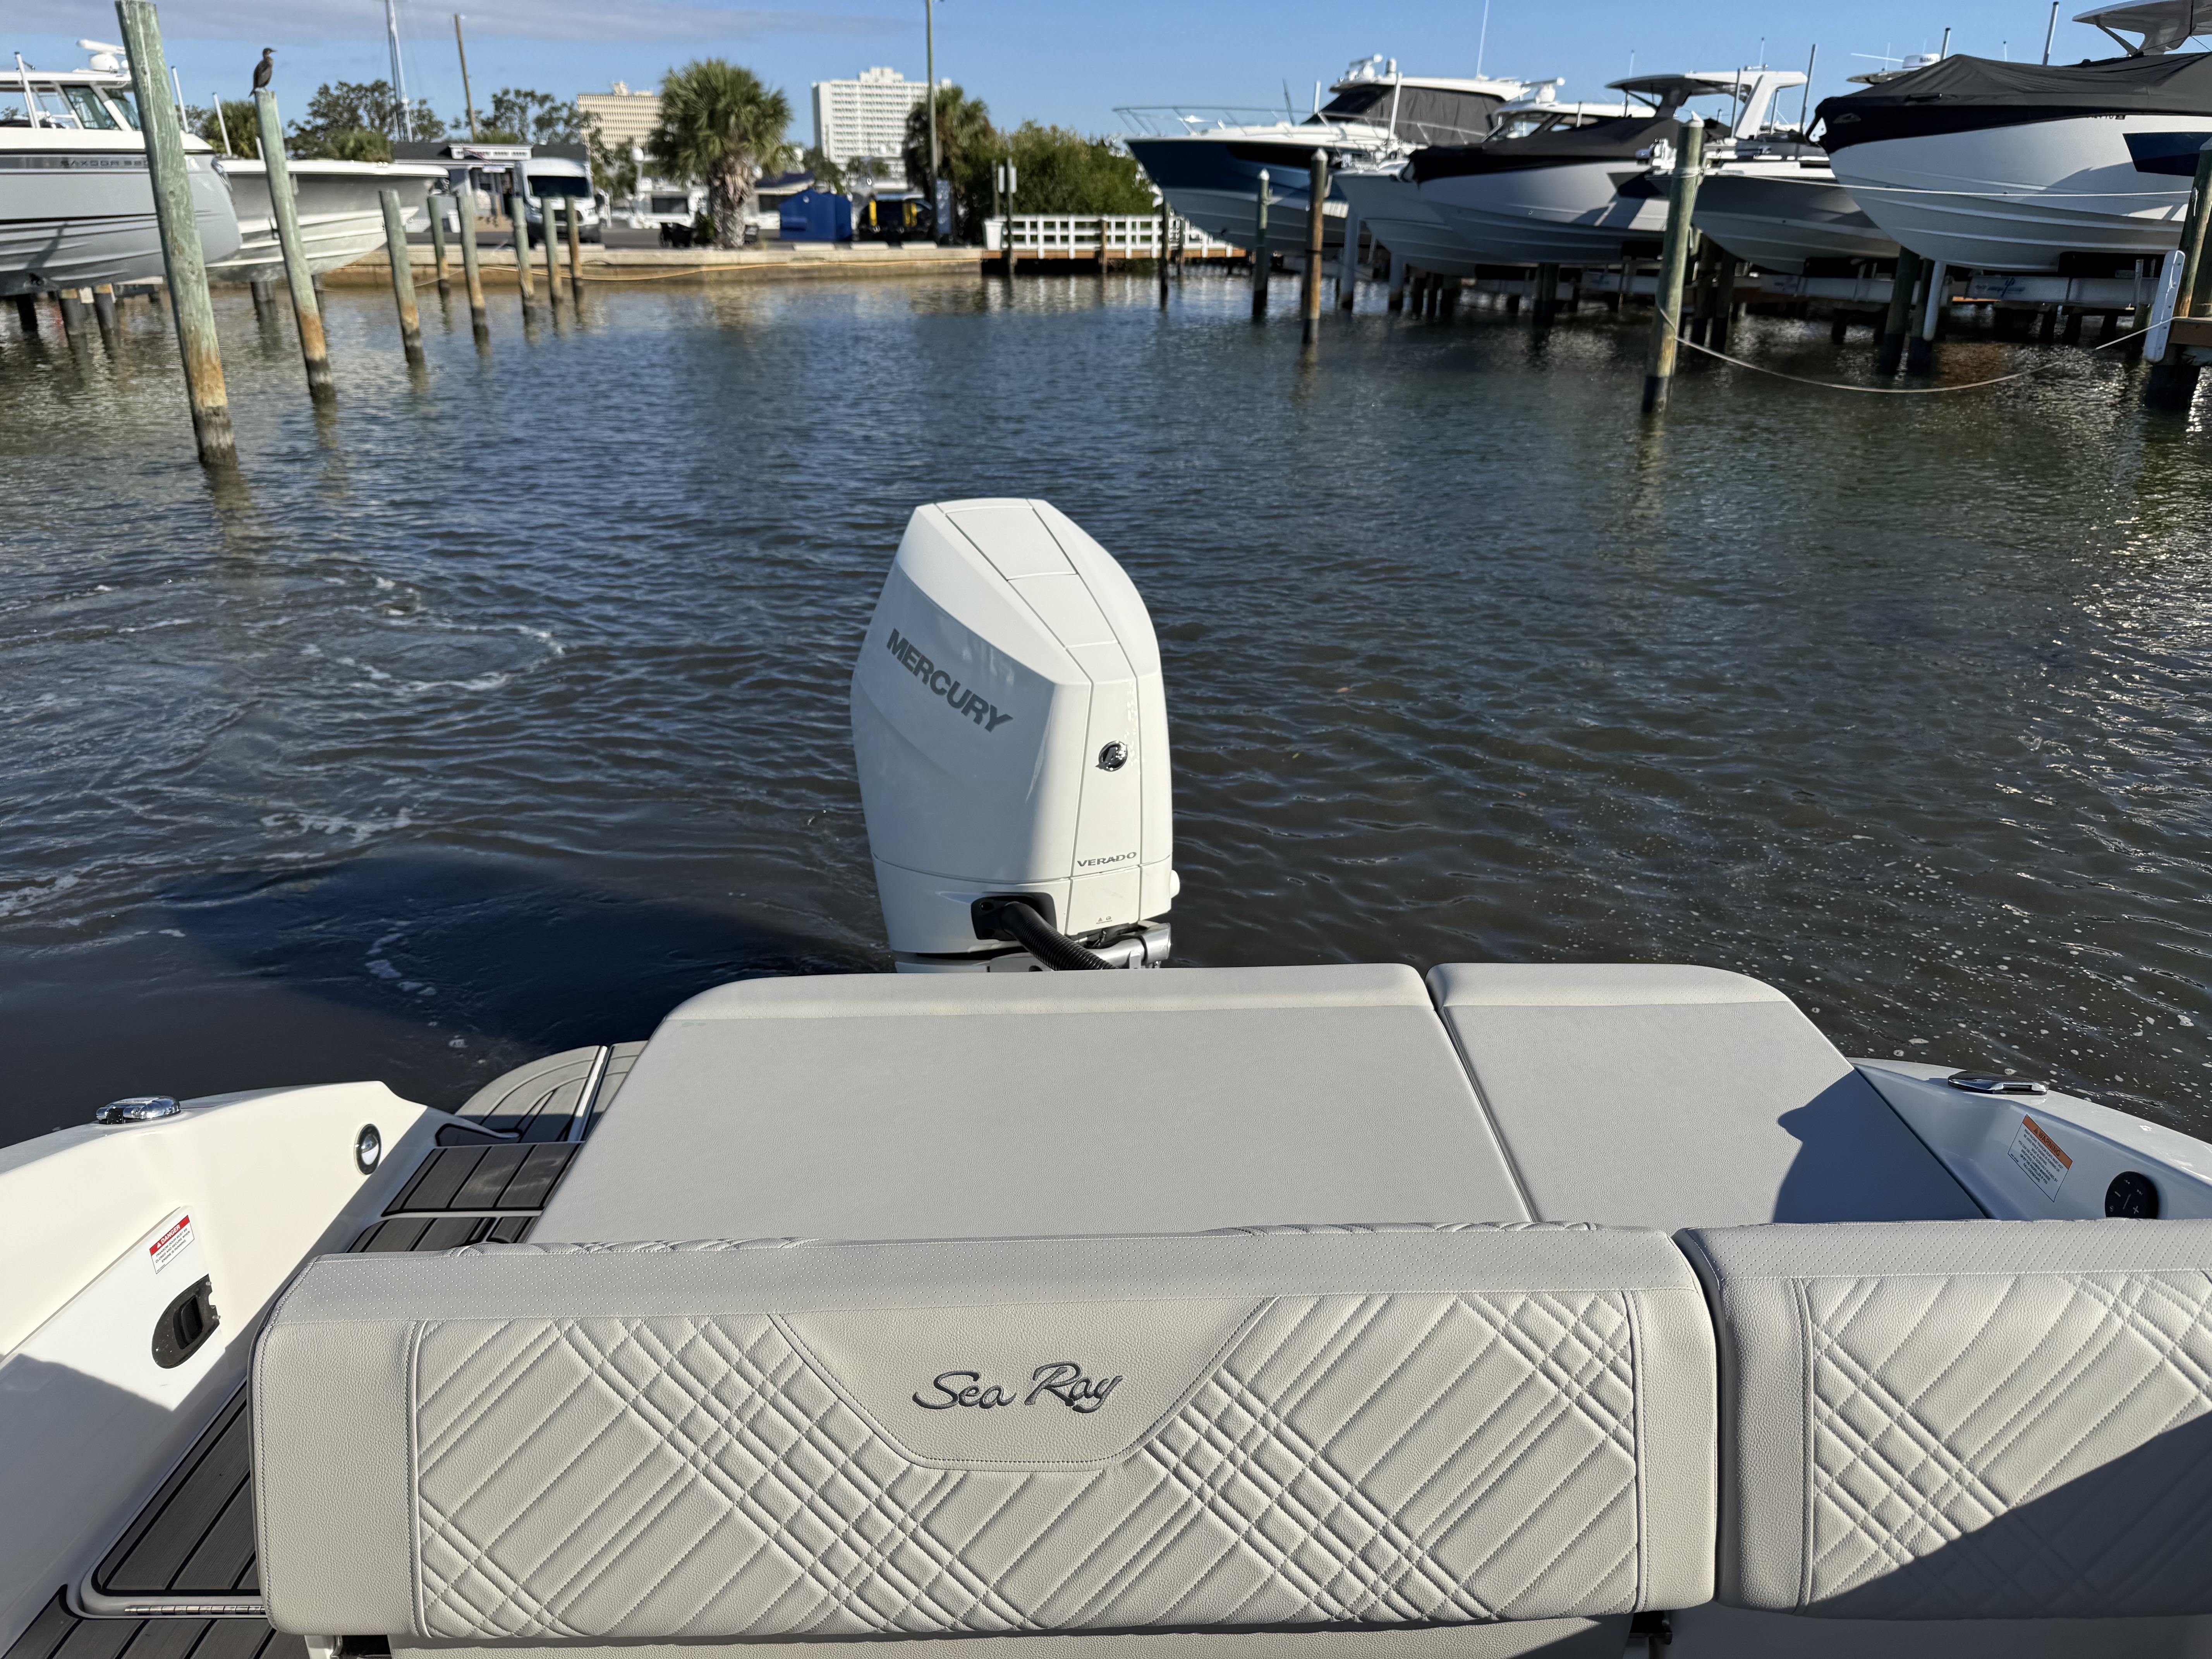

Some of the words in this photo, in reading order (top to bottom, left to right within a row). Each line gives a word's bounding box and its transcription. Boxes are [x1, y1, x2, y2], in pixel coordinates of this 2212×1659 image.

[886, 627, 1013, 733] MERCURY
[1077, 852, 1137, 867] VERADO
[2038, 1130, 2061, 1157] WARNING
[2029, 1163, 2042, 1178] PROPELLER
[160, 1223, 180, 1245] DANGER
[155, 1252, 166, 1263] CLOSED
[172, 1237, 182, 1248] SECURE
[182, 1230, 190, 1239] WHEN
[156, 1244, 168, 1257] TRANSOM
[161, 1252, 171, 1263] ENGINE
[912, 1370, 1017, 1410] Sea
[1024, 1361, 1123, 1413] Ray
